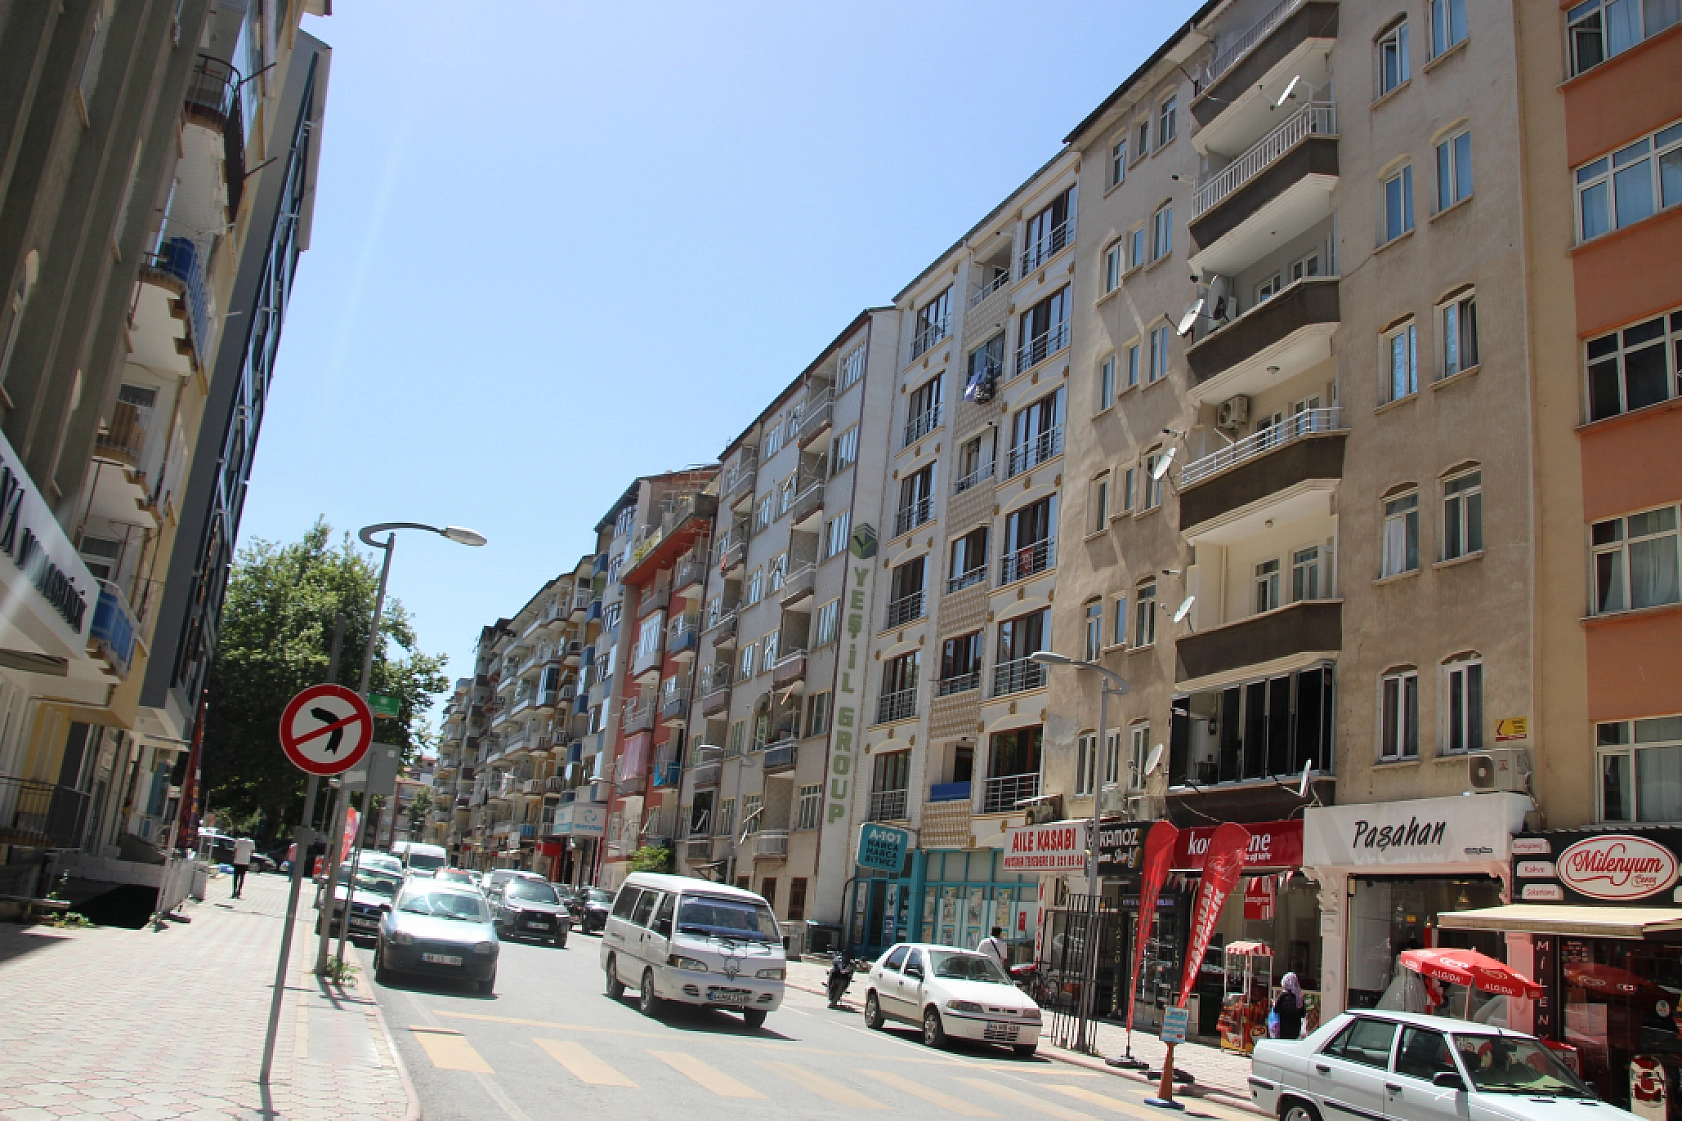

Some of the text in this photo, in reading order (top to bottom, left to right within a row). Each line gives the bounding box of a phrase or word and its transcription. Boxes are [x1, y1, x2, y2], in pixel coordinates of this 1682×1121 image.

[827, 706, 853, 825] GROUP
[868, 829, 901, 844] A-101
[1352, 816, 1447, 852] Paşahan
[1566, 842, 1665, 887] Milenyum
[1432, 969, 1461, 984] ALGIDA
[1484, 982, 1513, 995] ALGIDA
